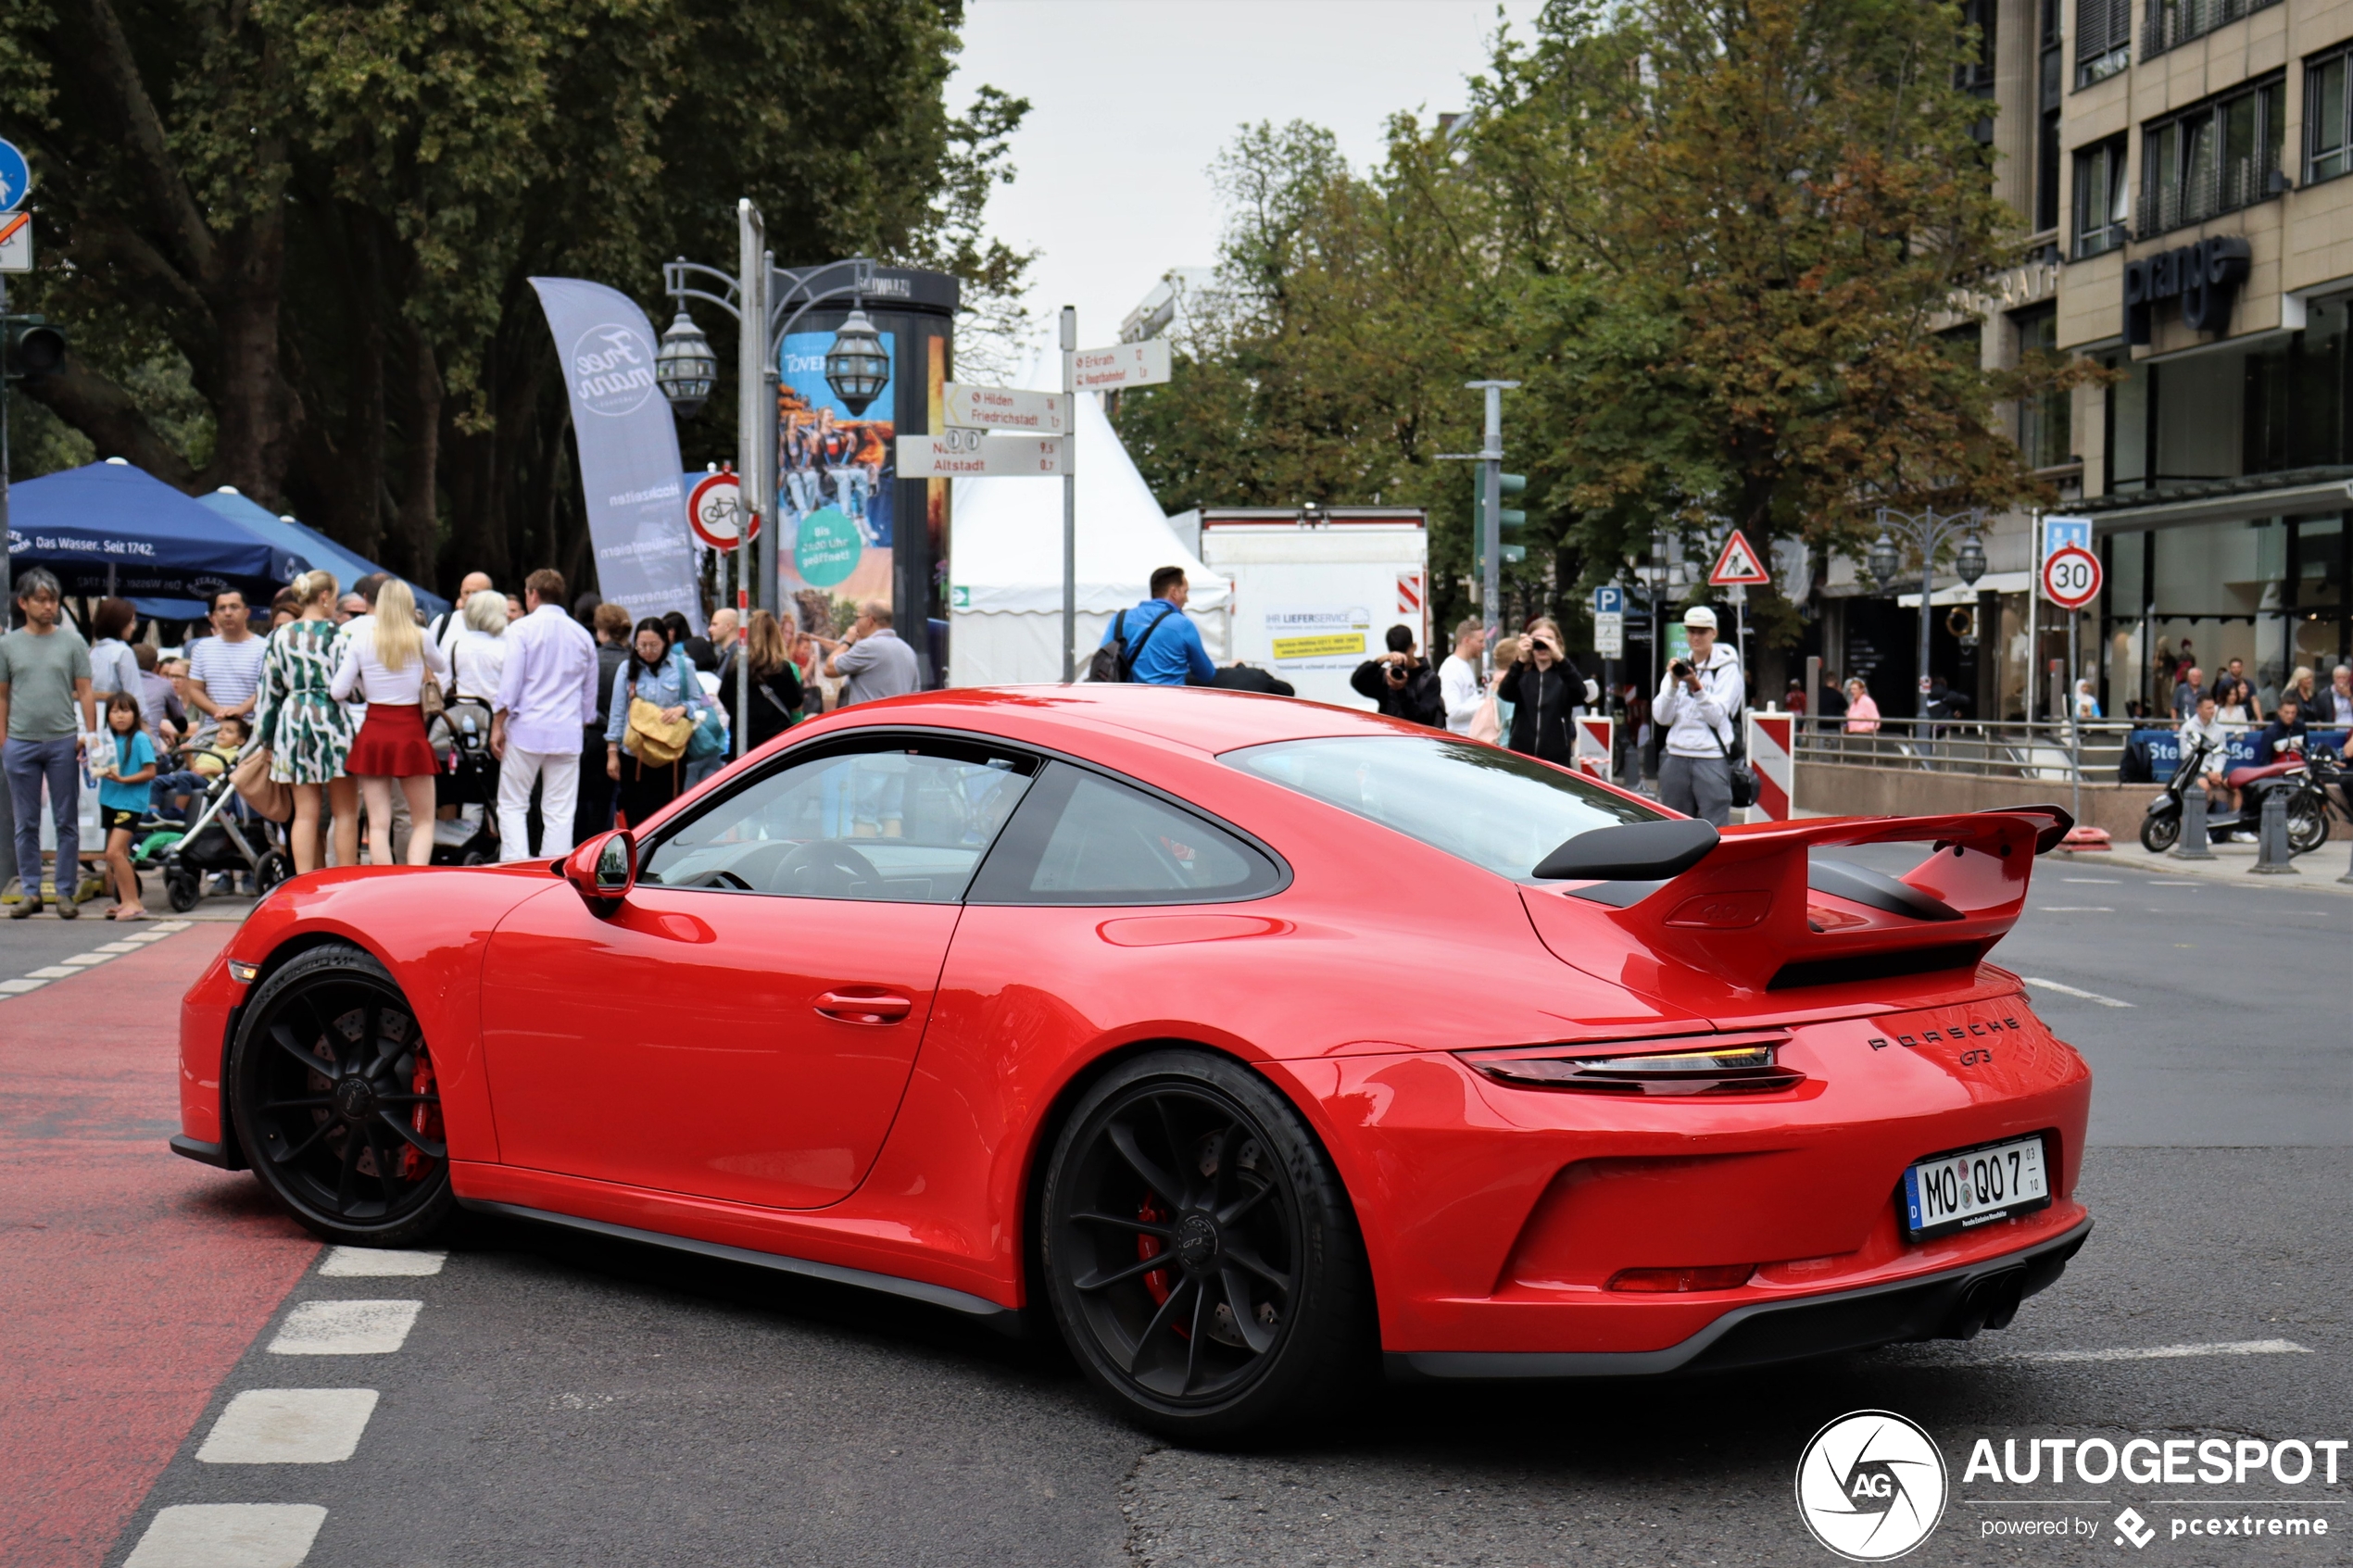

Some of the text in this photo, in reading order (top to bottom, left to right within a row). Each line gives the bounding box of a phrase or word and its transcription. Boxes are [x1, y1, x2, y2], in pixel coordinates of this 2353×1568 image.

[2122, 235, 2251, 345] prange
[1086, 348, 1142, 368] Erkrath 12
[1086, 369, 1126, 385] Hauptbahnhof
[984, 394, 1054, 410] Hilden 16
[972, 409, 1038, 426] Friedrichstadt
[934, 458, 985, 471] Altstadt
[35, 535, 57, 548] Das
[58, 537, 101, 551] Wasser.
[103, 540, 125, 553] Seit
[127, 542, 156, 556] 1742.
[2056, 563, 2087, 589] 30
[1601, 591, 1617, 611] P
[1265, 614, 1350, 623] IHR LIEFERSERVICE
[1869, 1017, 2020, 1051] PORSCHE
[1959, 1048, 1992, 1066] GT3
[2026, 1147, 2035, 1160] 03
[1925, 1165, 1957, 1218] MO
[2007, 1150, 2020, 1196] 7
[2030, 1178, 2039, 1192] 10
[1910, 1205, 1918, 1219] D
[1182, 1236, 1203, 1248] GT3
